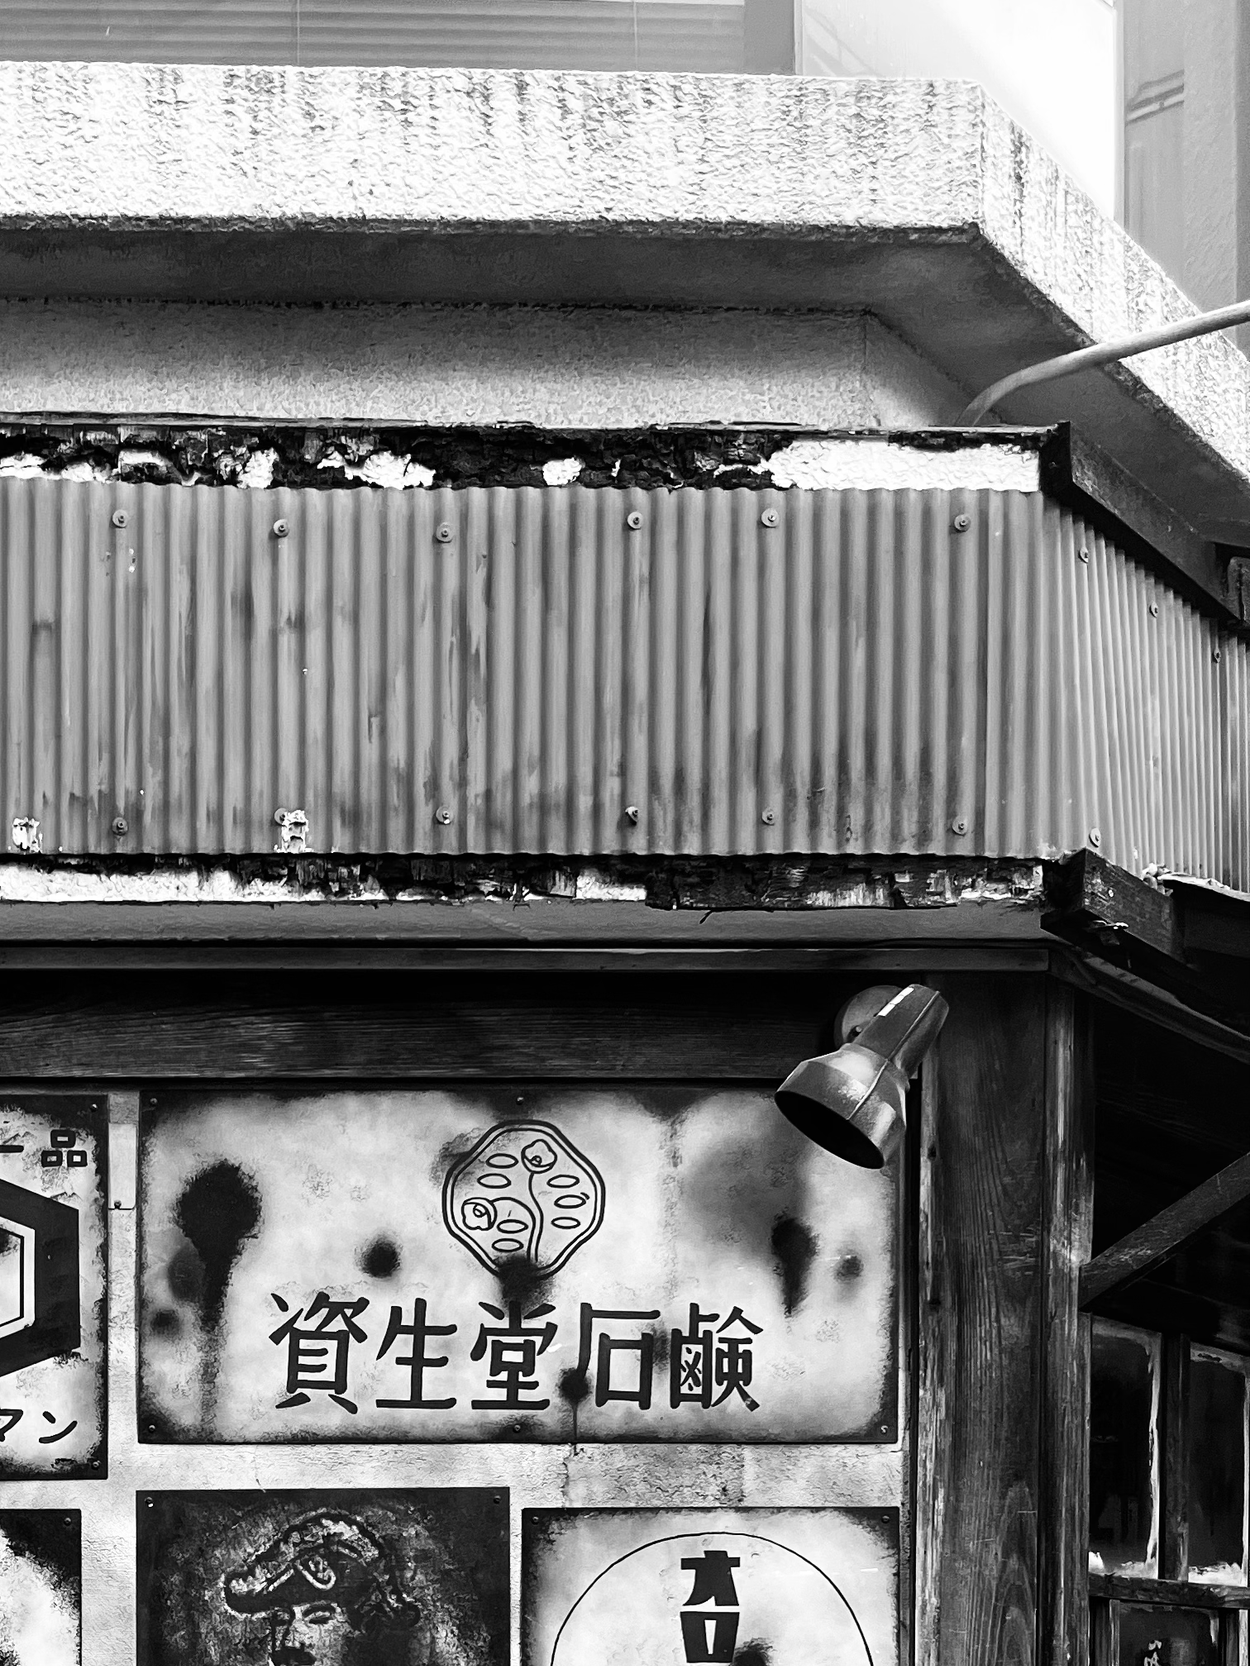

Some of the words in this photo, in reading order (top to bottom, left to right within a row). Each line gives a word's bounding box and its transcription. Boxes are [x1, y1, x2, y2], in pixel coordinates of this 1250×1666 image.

[268, 1292, 764, 1414] 資生堂石鹸
